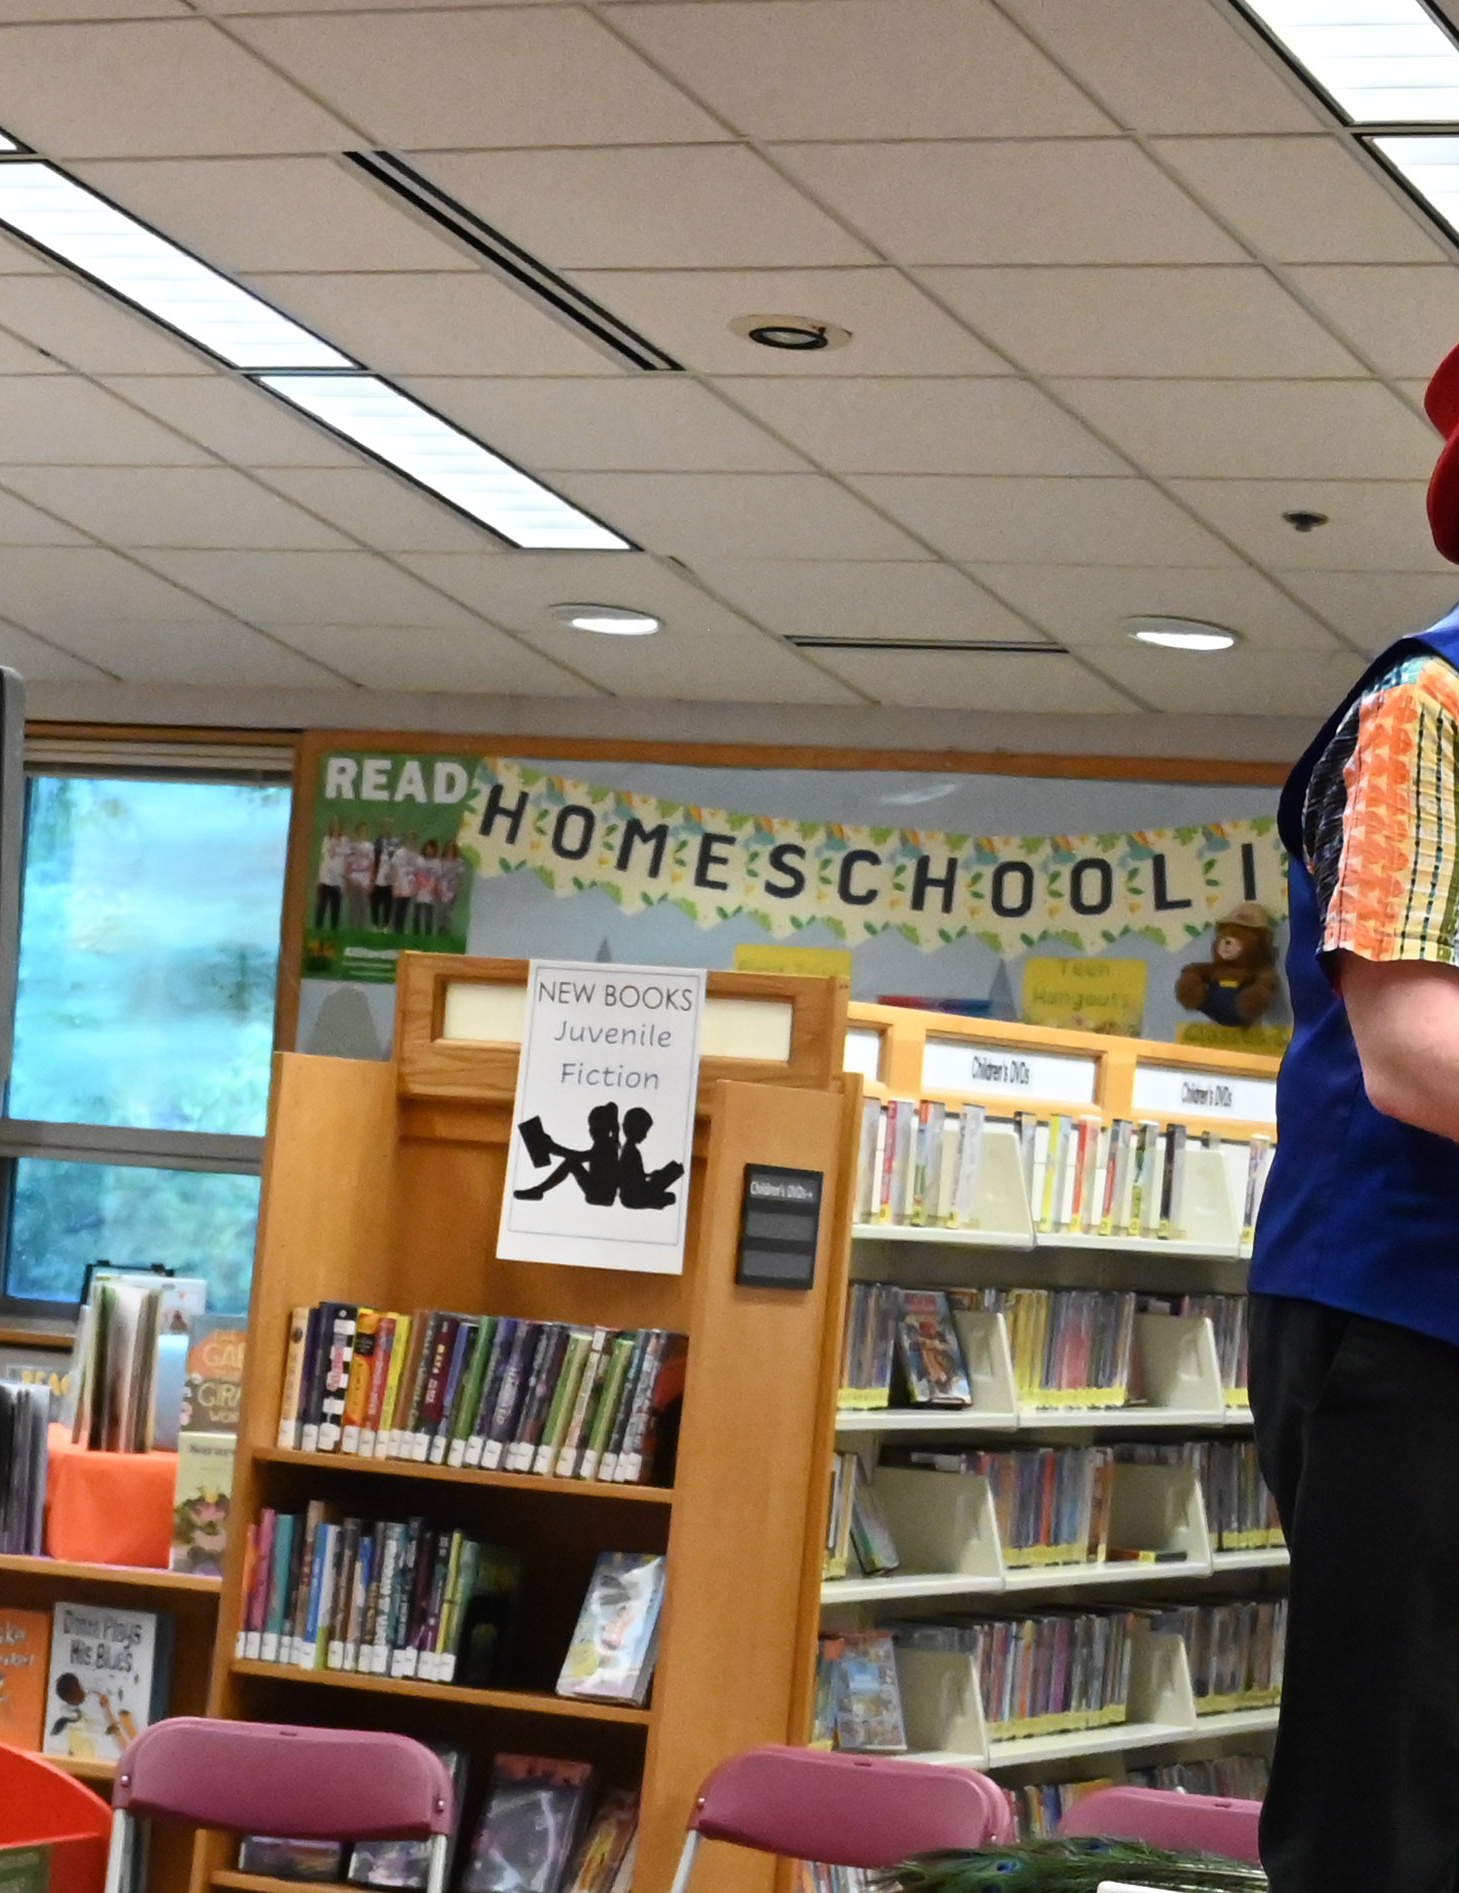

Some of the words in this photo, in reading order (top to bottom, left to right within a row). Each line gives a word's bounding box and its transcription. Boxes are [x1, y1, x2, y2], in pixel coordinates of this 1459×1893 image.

[325, 756, 469, 804] READ
[479, 783, 1259, 918] HOMESCHOOLI
[538, 981, 595, 1005] NEW
[604, 984, 693, 1012] BOOKS
[554, 1020, 673, 1048] Juvenile
[560, 1062, 659, 1090] Fiction
[972, 1055, 1006, 1085] Children's
[1008, 1064, 1031, 1087] DVDs
[70, 1638, 92, 1667] His
[95, 1642, 133, 1673] Blues
